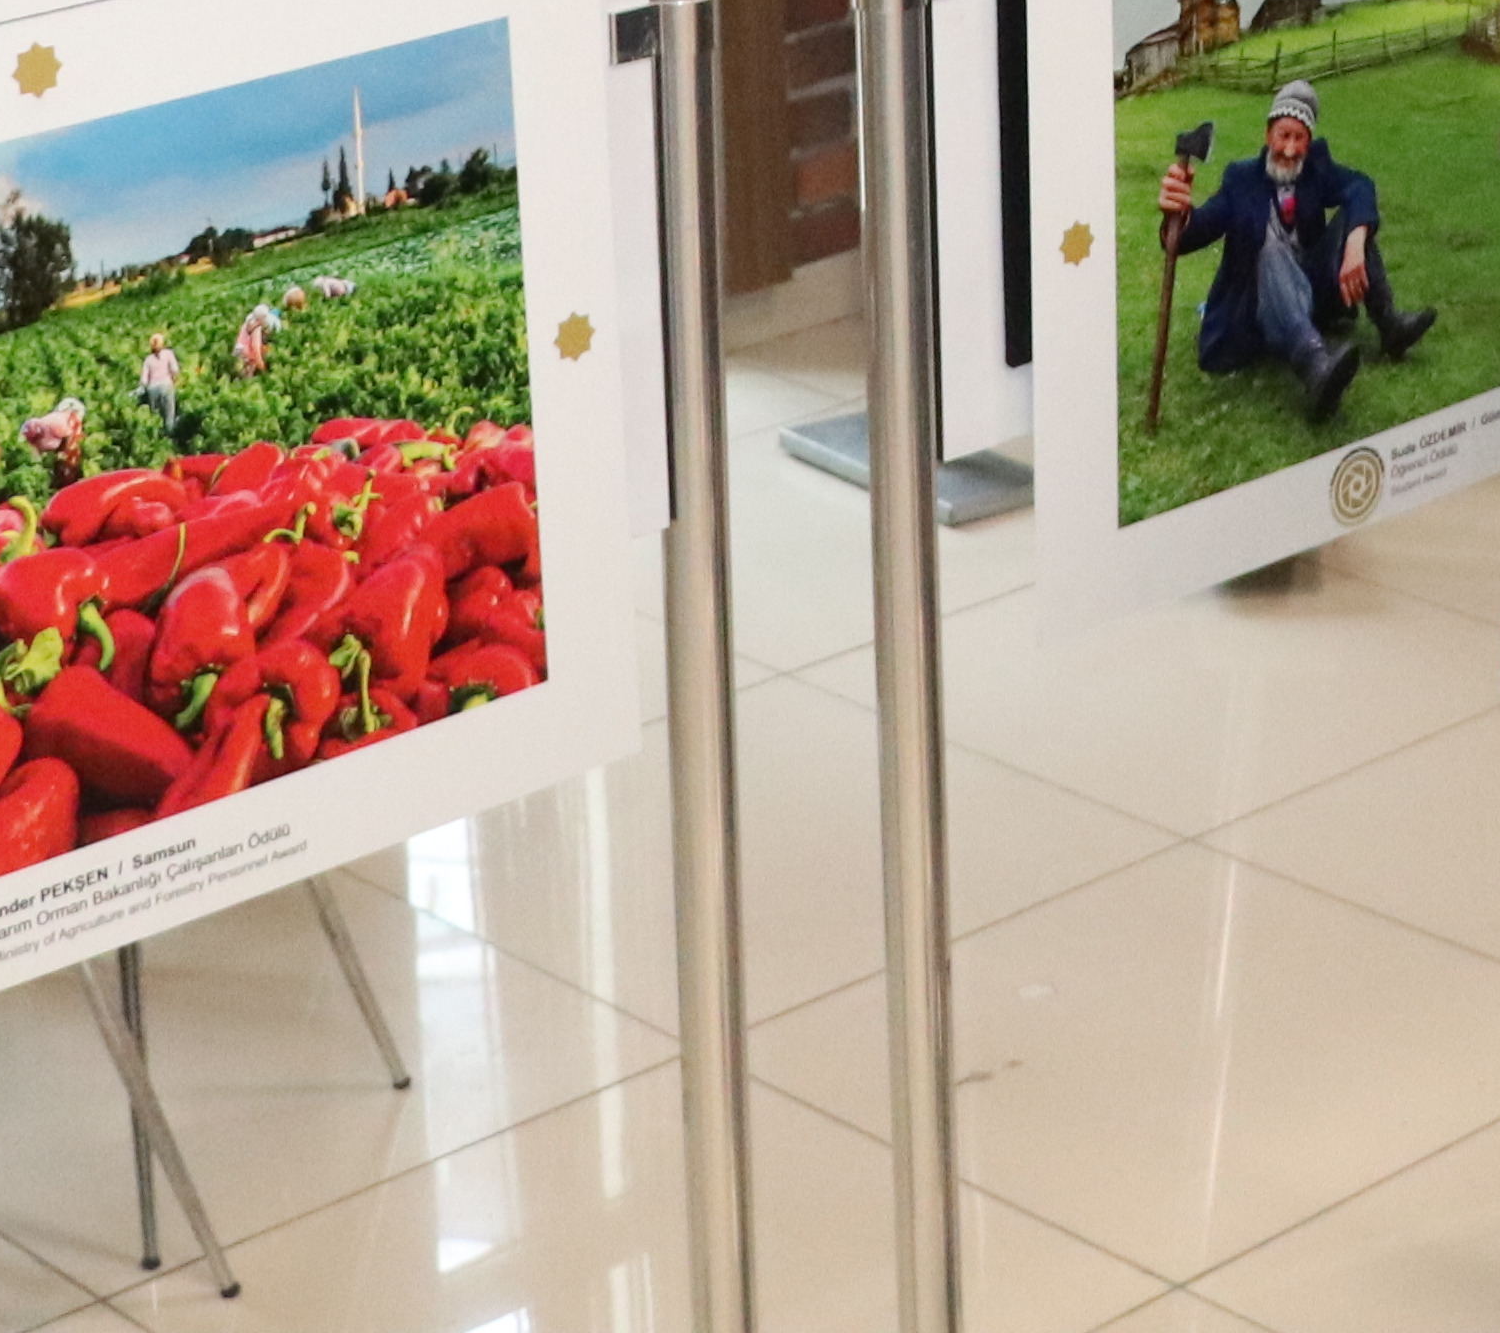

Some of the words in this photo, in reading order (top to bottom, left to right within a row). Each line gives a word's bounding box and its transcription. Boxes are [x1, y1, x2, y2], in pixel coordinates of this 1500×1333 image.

[36, 898, 89, 928] Orman
[92, 870, 163, 907] Bakanlığı
[165, 840, 245, 884] Çalışanları
[247, 822, 293, 849] Ödülü
[40, 865, 110, 903] PEKŞEN
[131, 837, 197, 870] Samsun
[43, 930, 57, 948] of
[58, 906, 126, 945] Agriculture
[128, 898, 153, 915] and
[155, 878, 206, 908] Forestry
[207, 853, 270, 887] Personnel
[271, 838, 309, 864] Award
